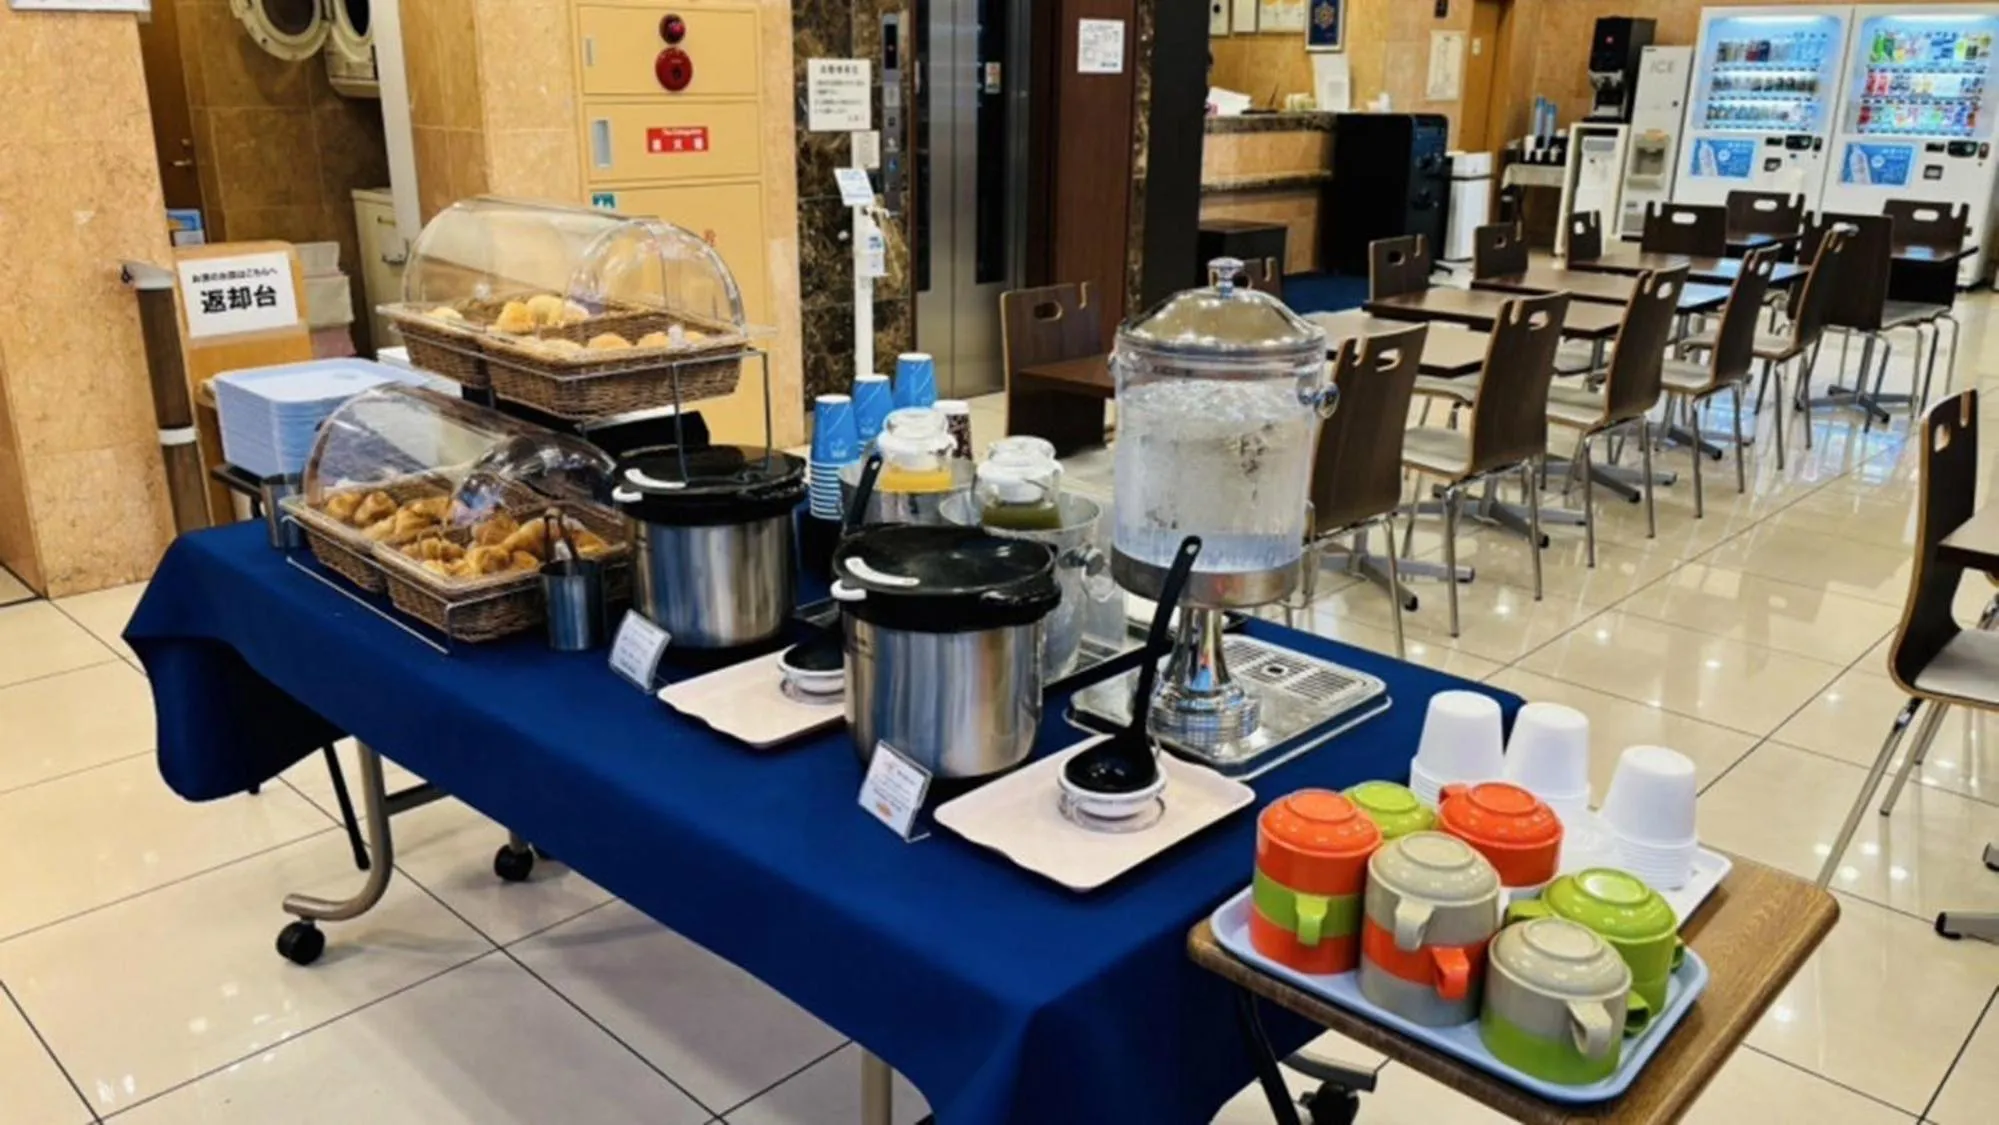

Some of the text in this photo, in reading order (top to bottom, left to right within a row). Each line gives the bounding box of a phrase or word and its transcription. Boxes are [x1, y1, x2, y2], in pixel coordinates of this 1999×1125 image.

[1649, 59, 1675, 73] ICE
[201, 284, 277, 314] 返却台
